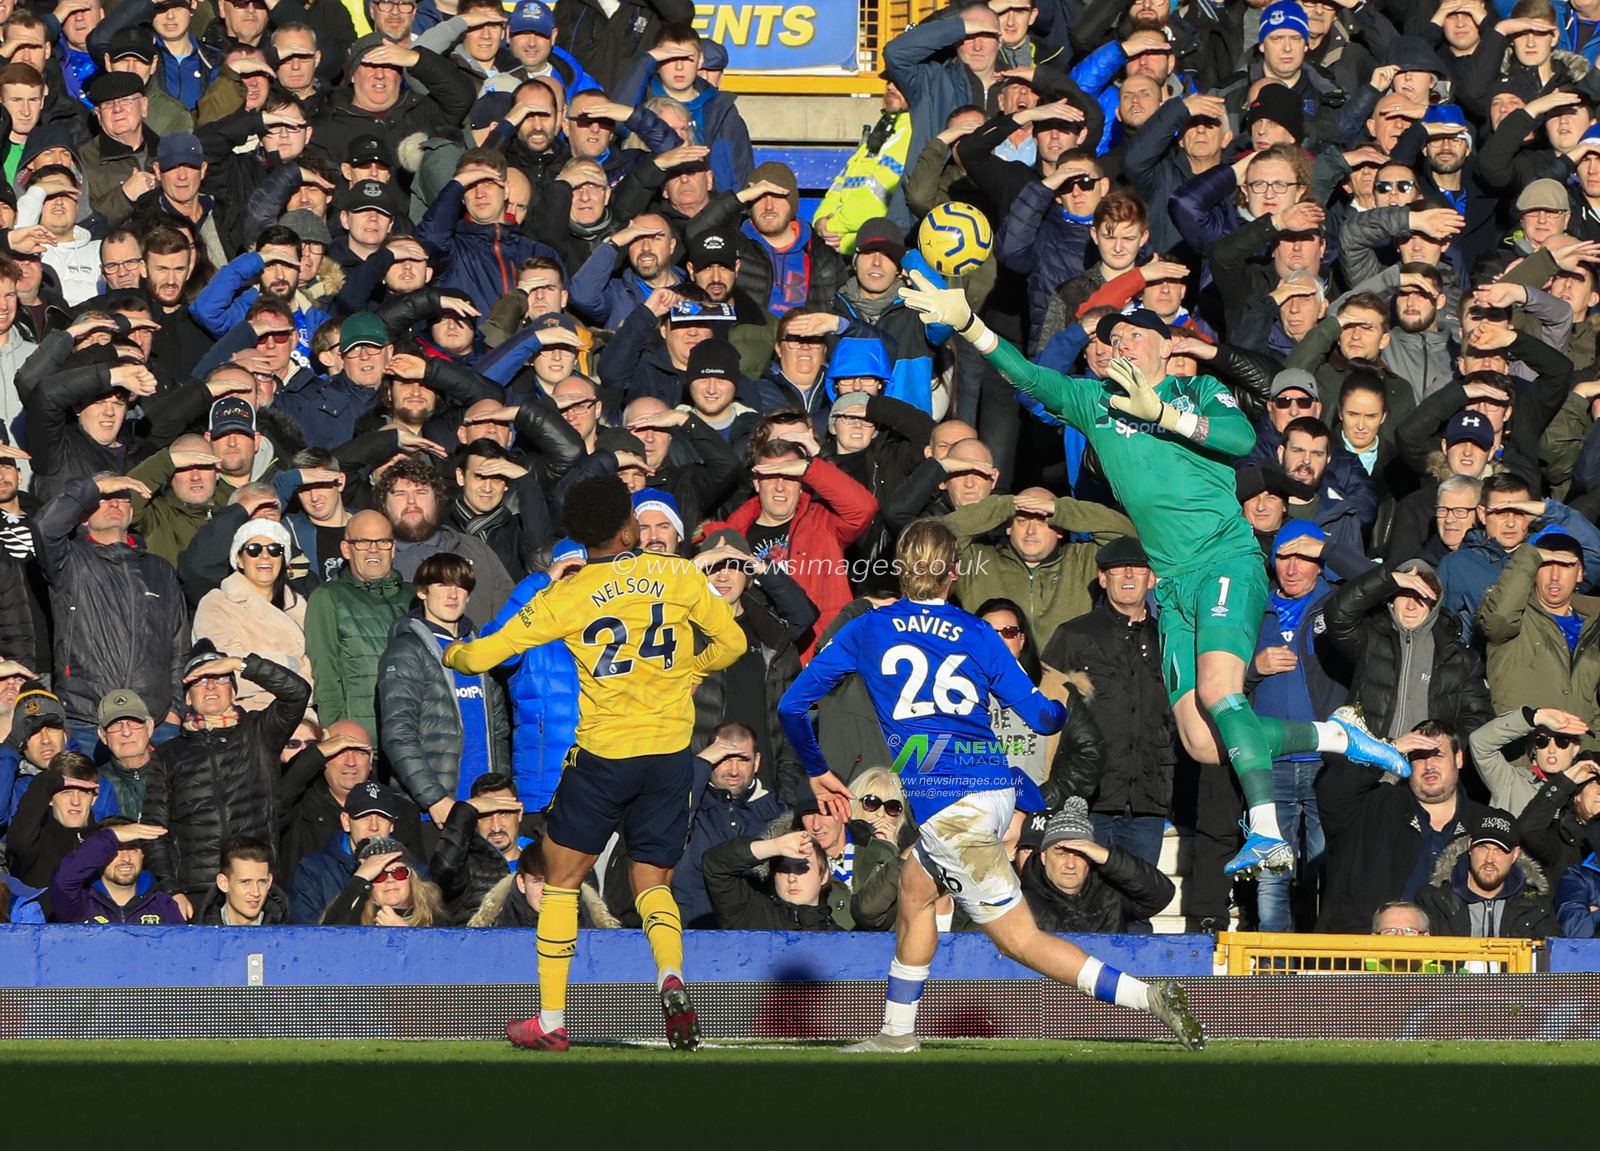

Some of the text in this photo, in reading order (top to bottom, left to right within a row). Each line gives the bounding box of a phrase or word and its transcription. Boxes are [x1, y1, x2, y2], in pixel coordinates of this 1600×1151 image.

[591, 577, 665, 608] NELSON
[1218, 576, 1231, 606] 1
[582, 602, 678, 678] 24
[892, 615, 963, 642] DAVIES
[881, 644, 980, 720] 26
